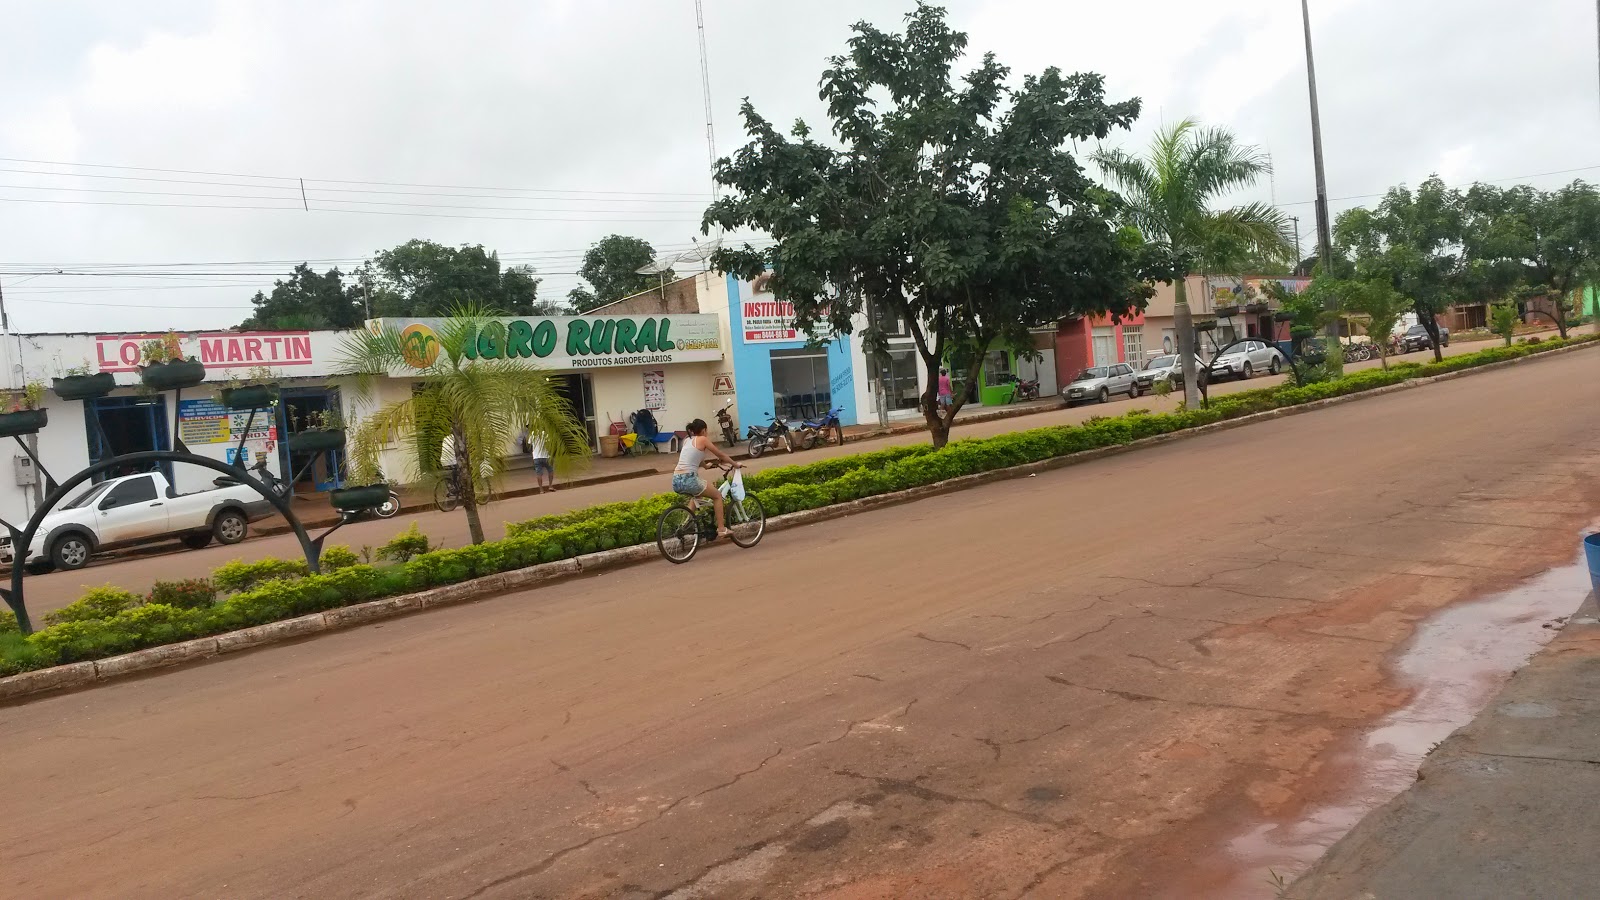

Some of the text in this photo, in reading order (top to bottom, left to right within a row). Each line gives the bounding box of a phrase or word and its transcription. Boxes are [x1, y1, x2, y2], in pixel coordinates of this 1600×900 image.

[744, 302, 793, 318] INSTITUTO
[463, 317, 676, 360] AGRO RURAL
[96, 337, 313, 367] LOA MARTIN
[572, 354, 673, 367] PRODUTOS AGROPECUÁRIOS
